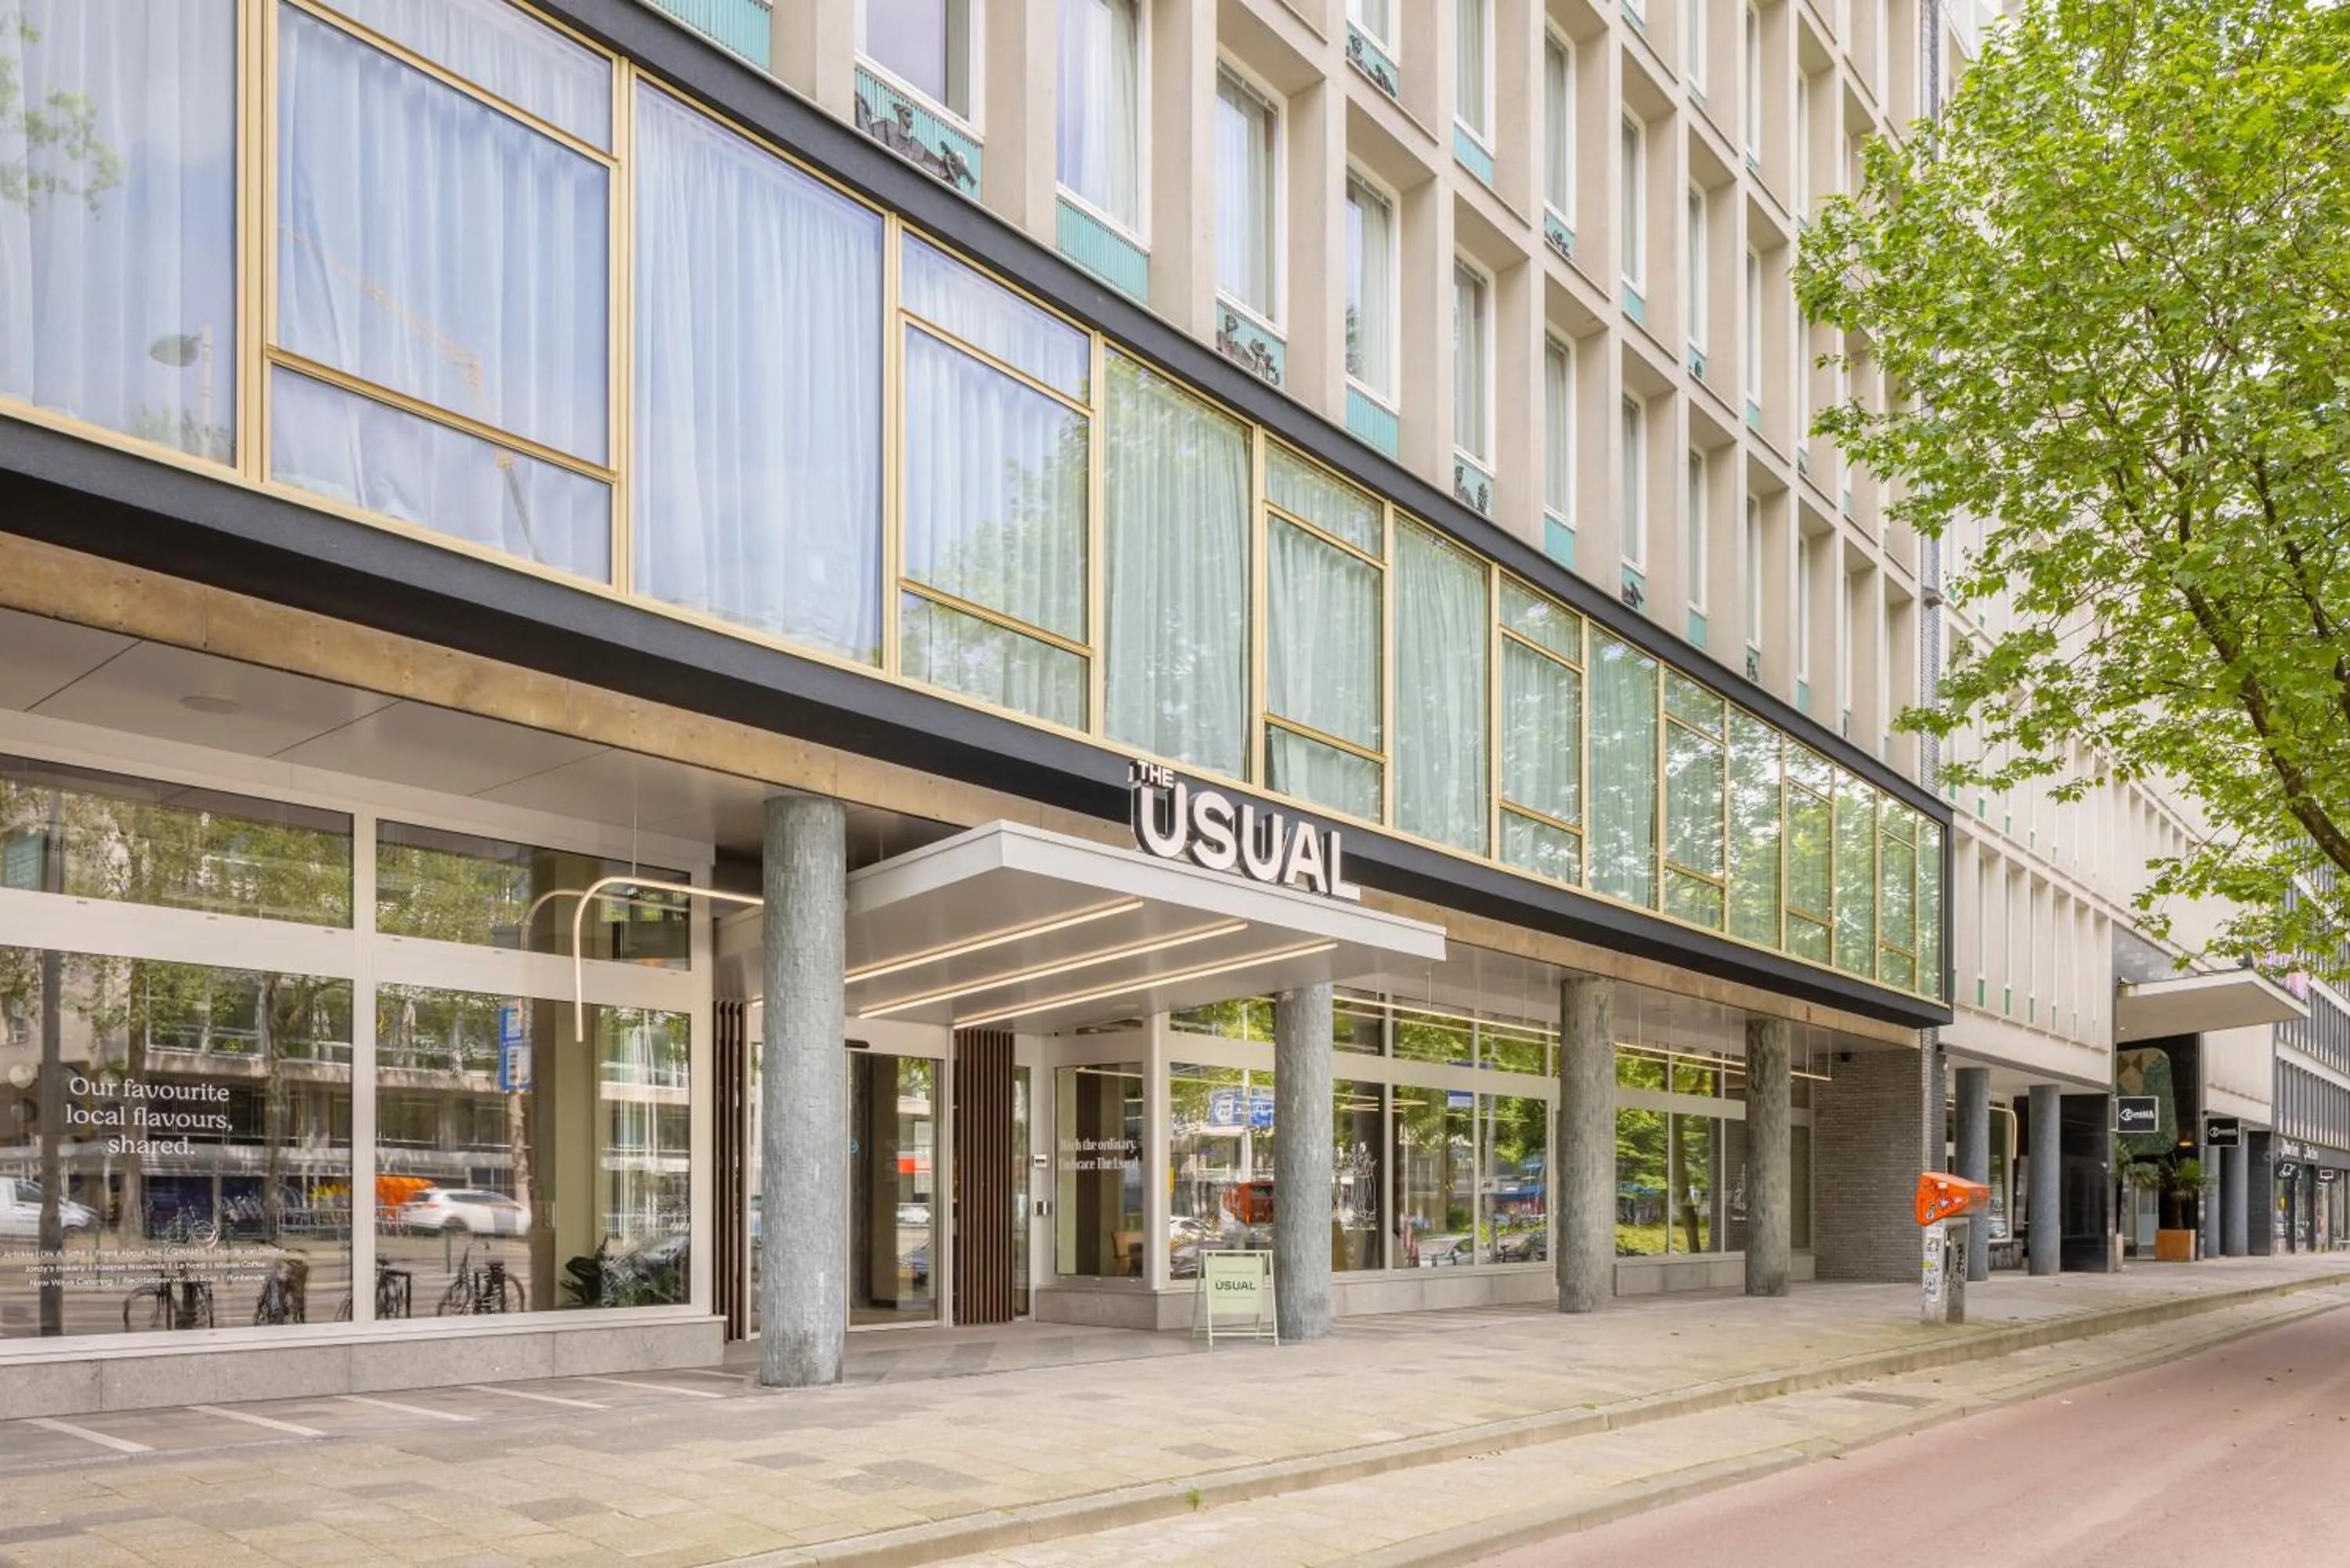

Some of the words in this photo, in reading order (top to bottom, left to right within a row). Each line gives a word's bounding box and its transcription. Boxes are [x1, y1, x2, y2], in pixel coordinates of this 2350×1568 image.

[1136, 759, 1174, 787] THE
[1133, 782, 1361, 901] USUAL
[70, 1077, 118, 1096] Our
[124, 1078, 230, 1101] favourite
[66, 1104, 125, 1125] local
[133, 1107, 233, 1131] flavours,
[107, 1135, 195, 1155] shared.
[1215, 1279, 1256, 1291] USUAL
